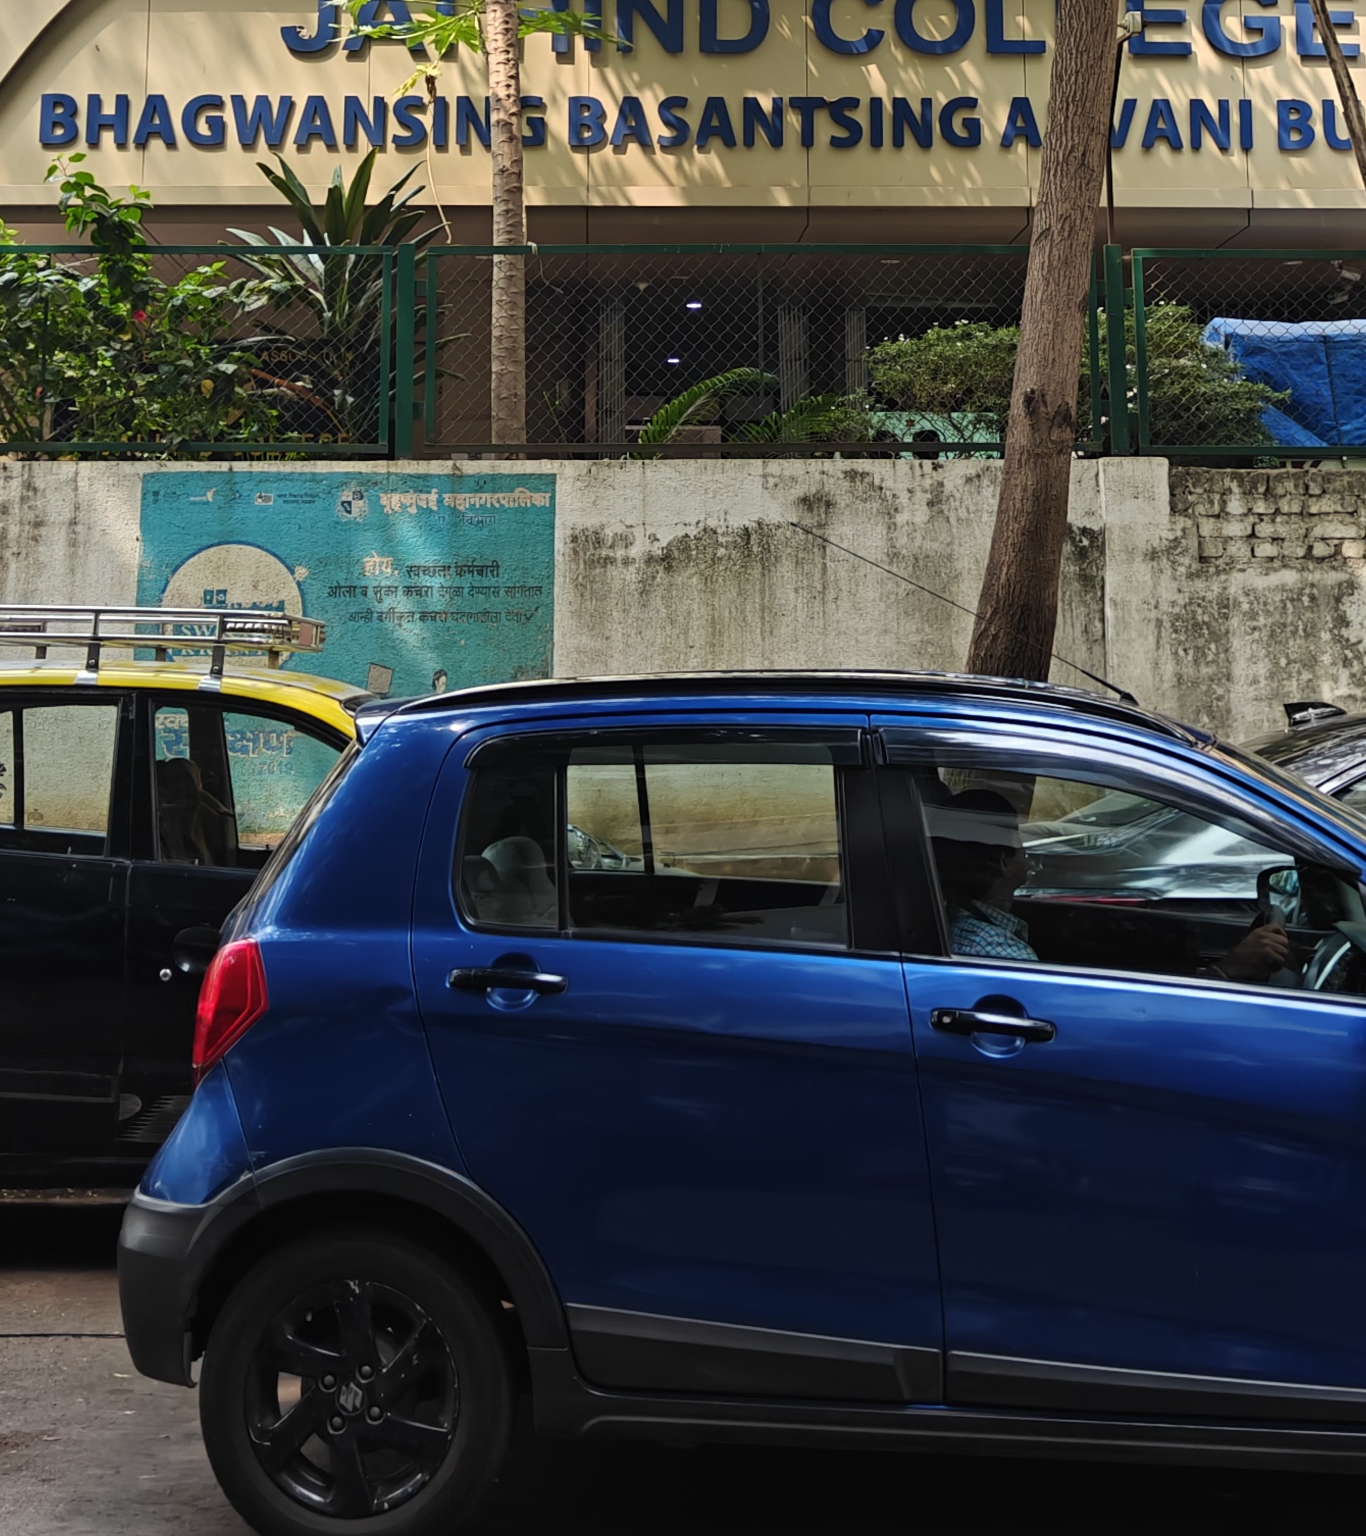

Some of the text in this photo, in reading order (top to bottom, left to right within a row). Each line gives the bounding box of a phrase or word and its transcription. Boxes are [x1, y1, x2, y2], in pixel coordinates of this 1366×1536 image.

[40, 92, 545, 148] BHAGWANSING
[568, 94, 981, 149] BASANTSING
[1000, 96, 1254, 151] AVANI
